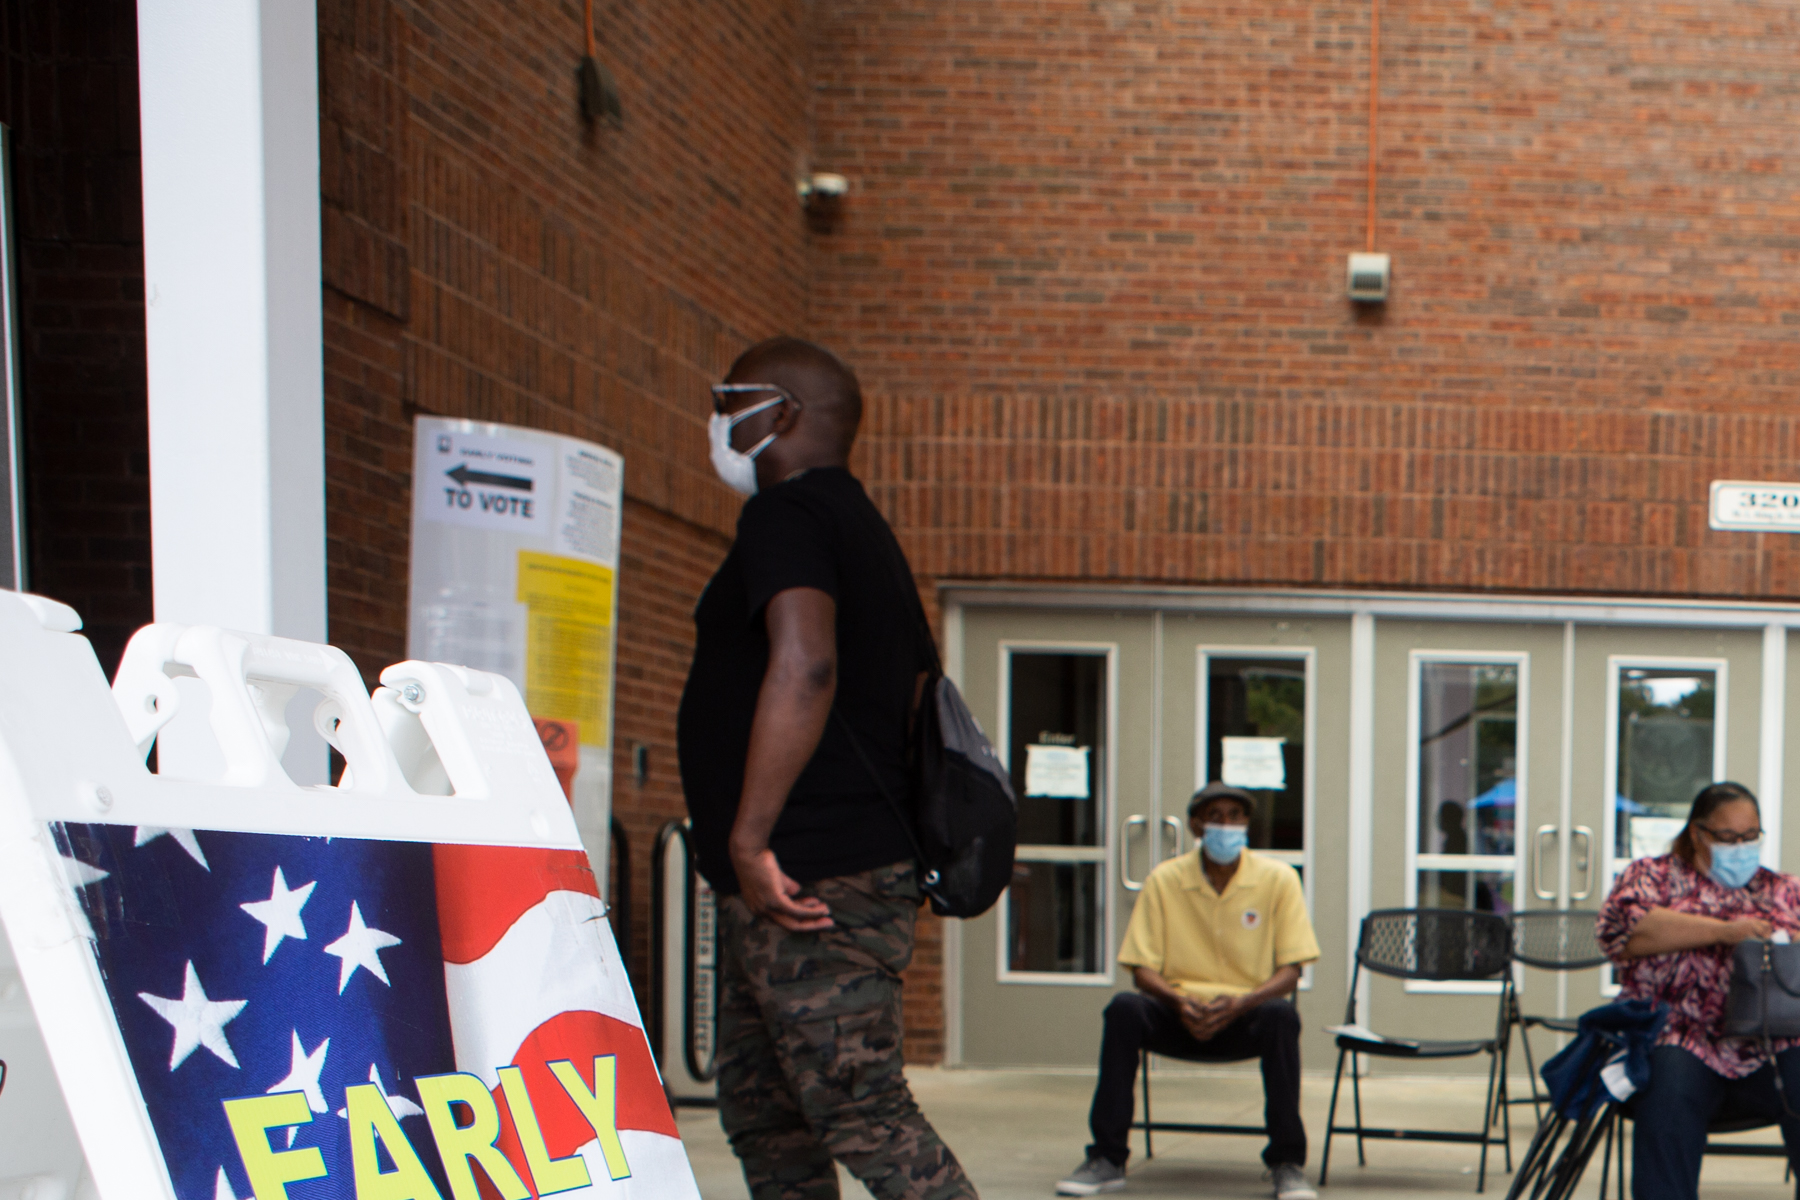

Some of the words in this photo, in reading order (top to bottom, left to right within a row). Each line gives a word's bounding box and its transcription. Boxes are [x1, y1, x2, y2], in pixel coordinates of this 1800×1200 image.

[445, 487, 473, 509] TO
[479, 491, 535, 519] VOTE
[695, 963, 717, 1052] Inquirer
